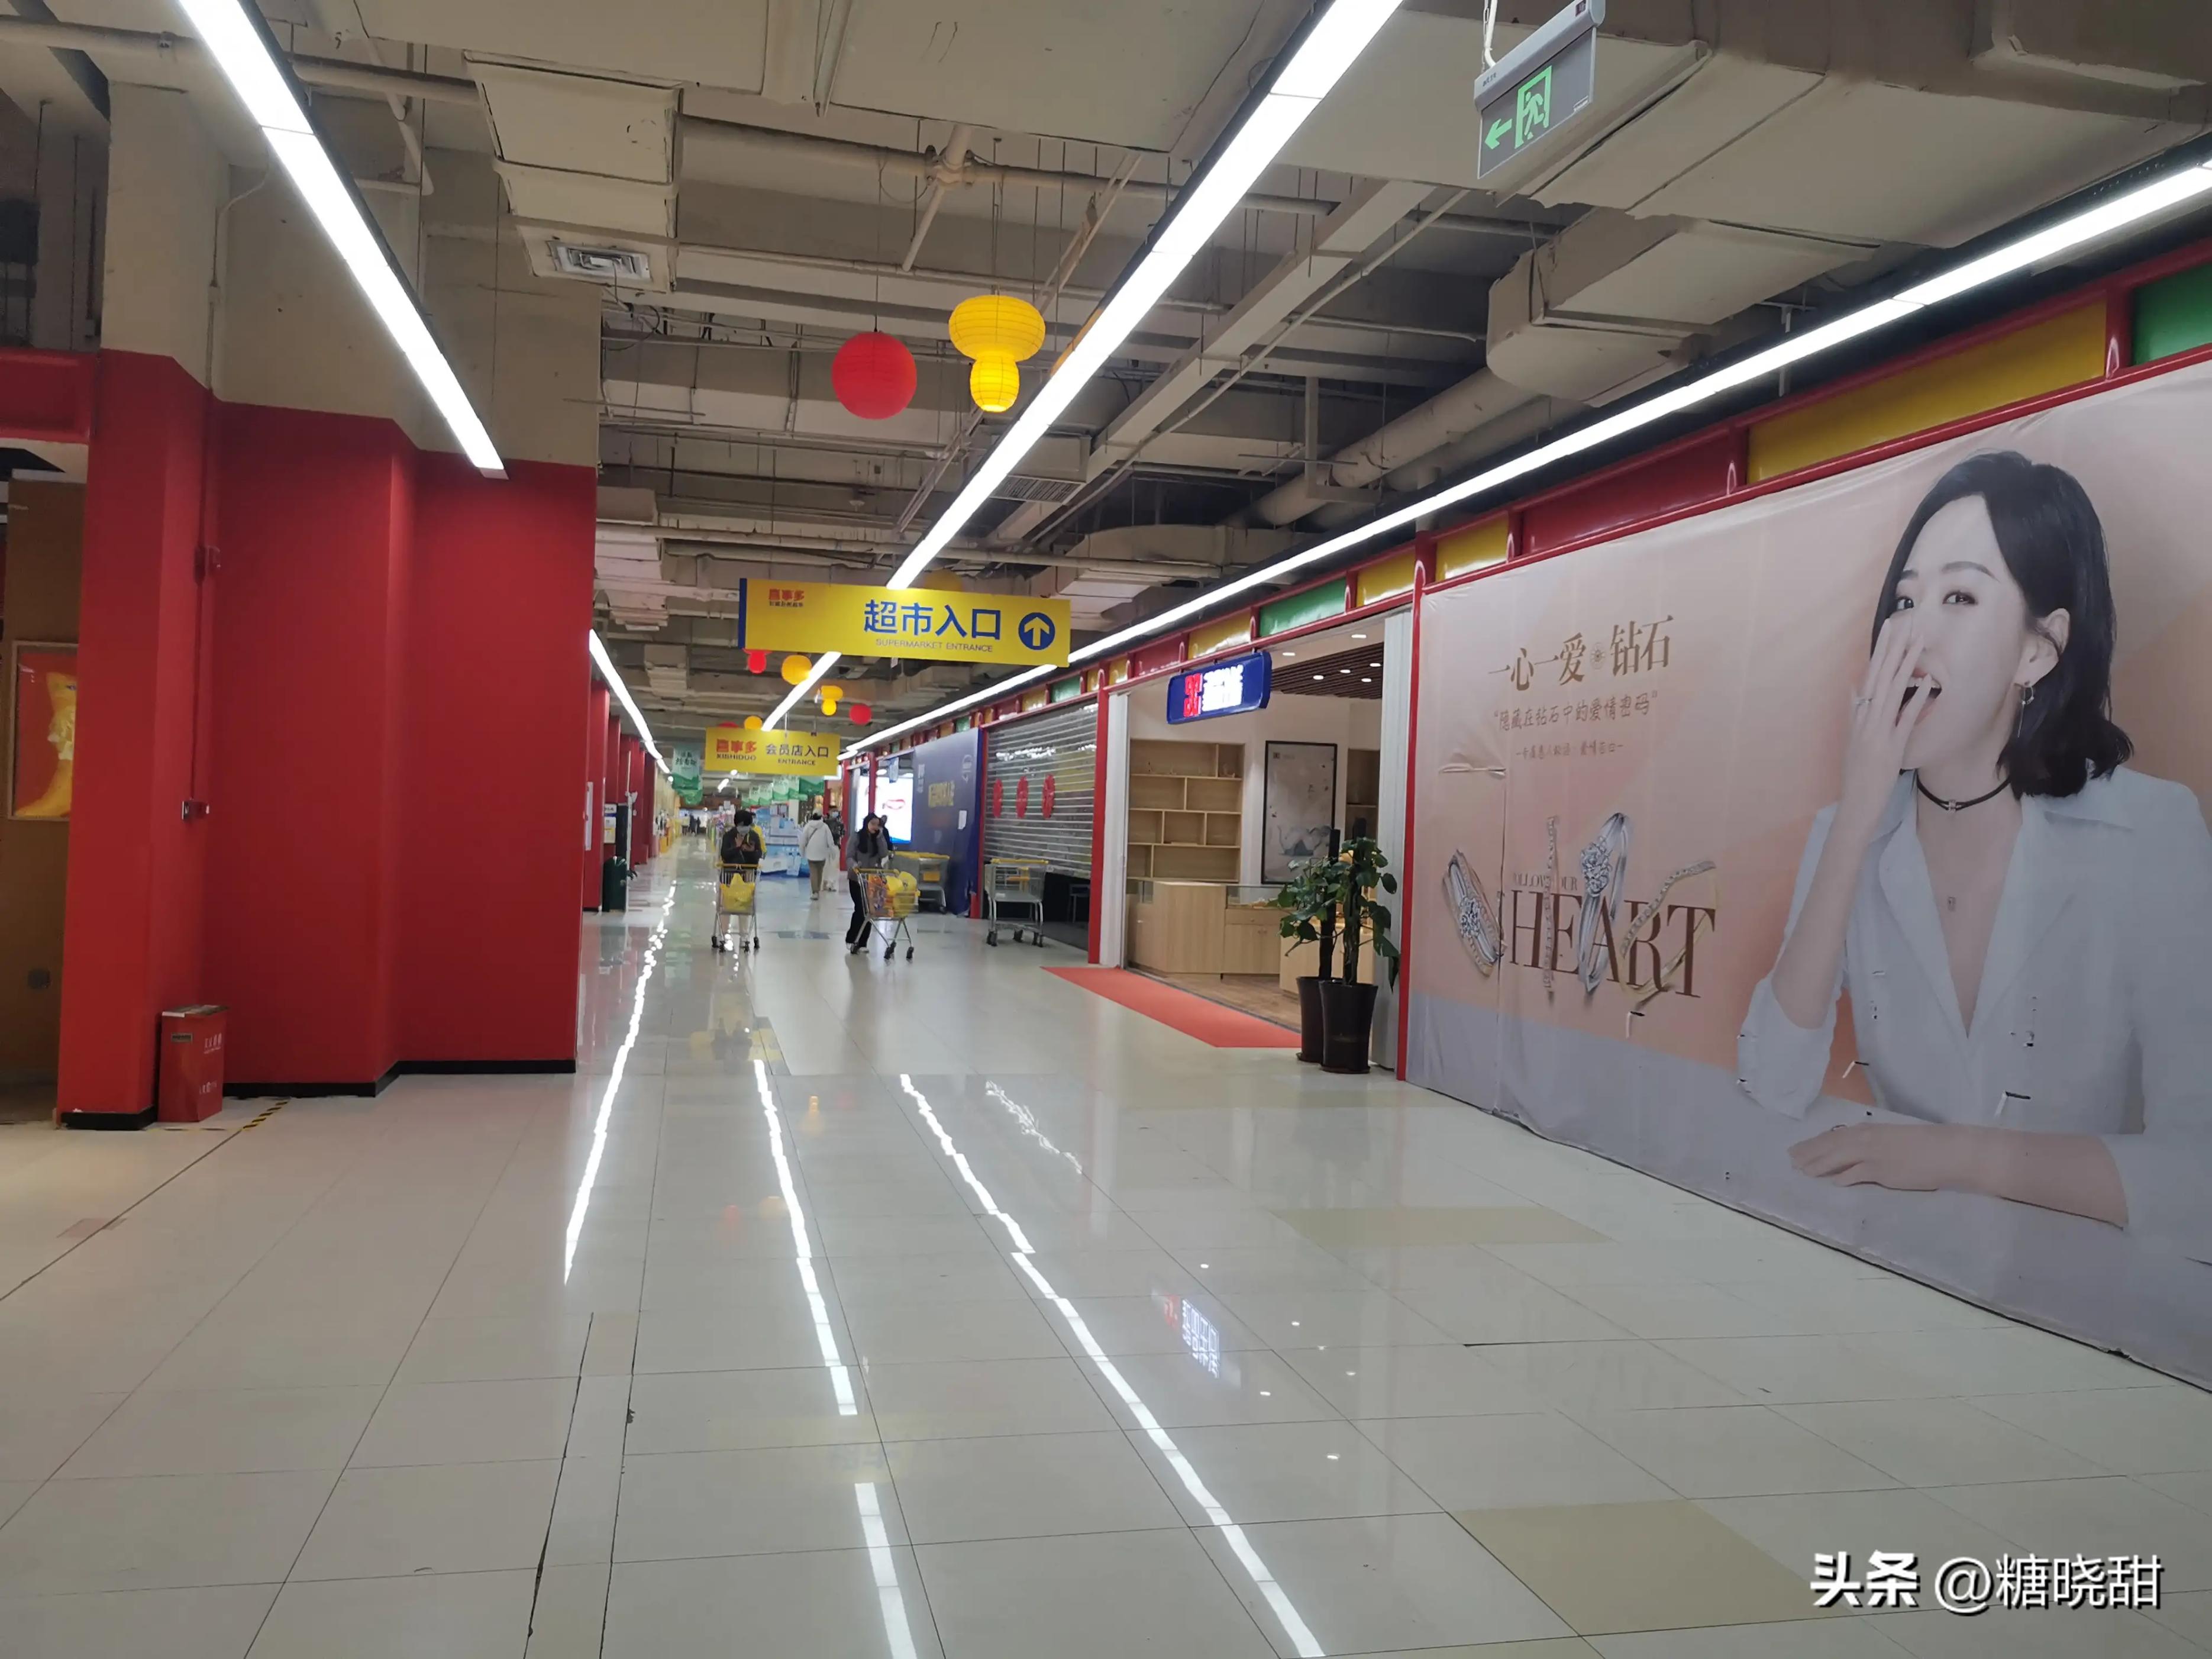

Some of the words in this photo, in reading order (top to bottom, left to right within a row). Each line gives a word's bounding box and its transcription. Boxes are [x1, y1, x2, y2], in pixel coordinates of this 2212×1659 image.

[864, 599, 1001, 640] 超市入口
[876, 638, 942, 649] SUPERMARKET
[946, 643, 993, 652] ENTRANCE
[1487, 631, 1587, 691] 一心一爱
[1610, 615, 1674, 677] 钻石
[716, 753, 756, 761] XISHIDUO
[766, 743, 829, 758] 会员店入口
[778, 758, 816, 766] ENTRANCE
[1510, 889, 1716, 999] HEART
